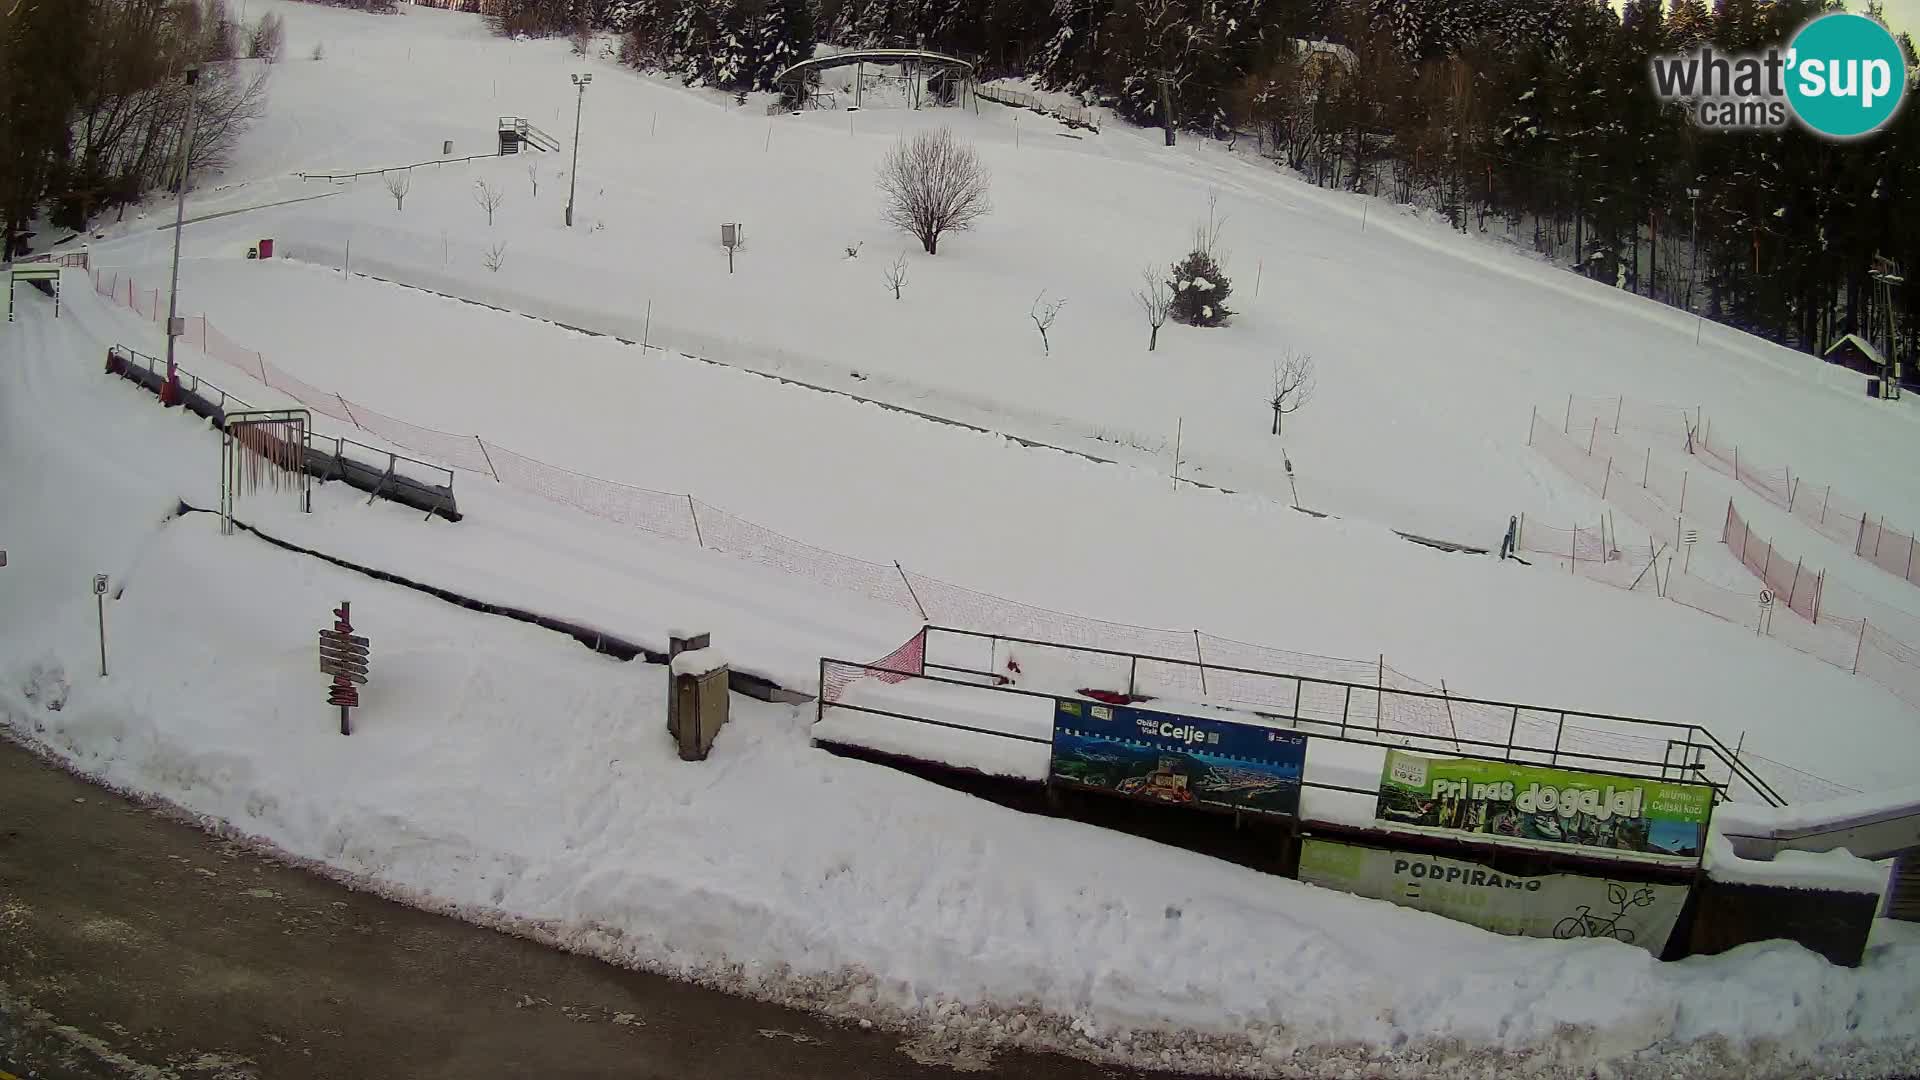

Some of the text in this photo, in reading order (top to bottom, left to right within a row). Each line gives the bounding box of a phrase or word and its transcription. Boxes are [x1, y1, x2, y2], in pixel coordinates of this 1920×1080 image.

[1160, 722, 1205, 745] Celje
[1431, 777, 1469, 801] Pri
[1472, 780, 1514, 801] nas
[1516, 782, 1643, 821] dogaja!
[1394, 859, 1541, 891] PODPIRAMO
